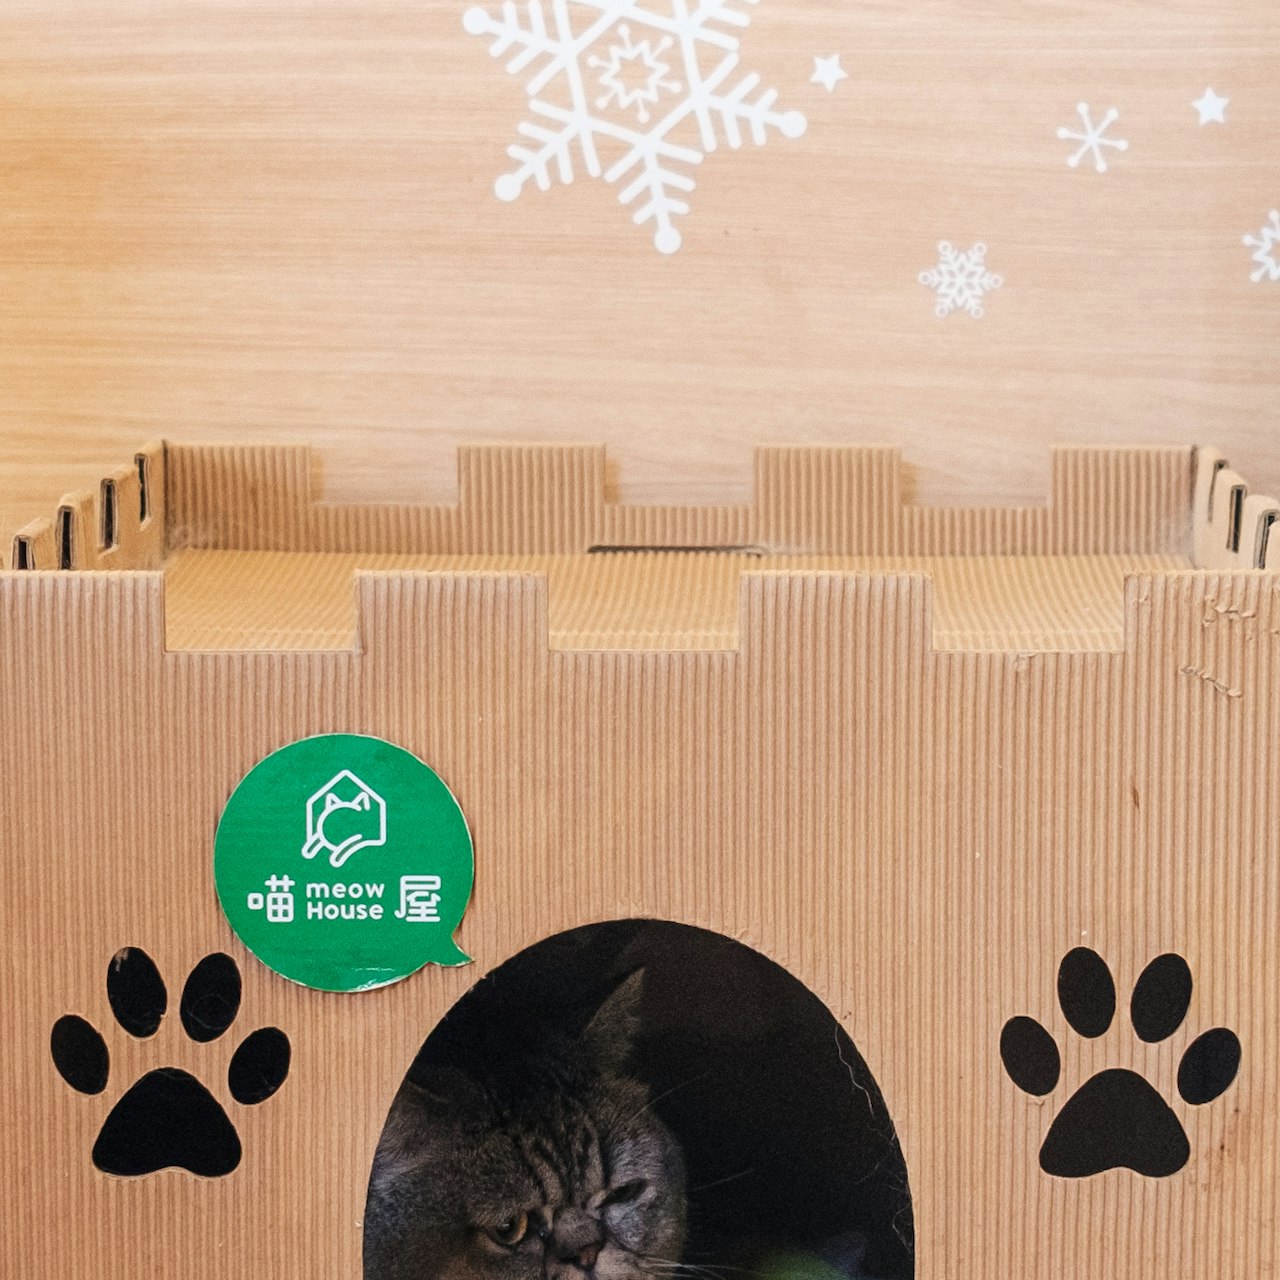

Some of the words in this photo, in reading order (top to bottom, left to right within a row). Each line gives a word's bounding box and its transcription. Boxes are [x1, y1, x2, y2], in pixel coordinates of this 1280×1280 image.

[247, 874, 296, 923] 喵
[394, 875, 442, 923] 屋
[306, 882, 385, 899] meow
[306, 901, 384, 920] House
